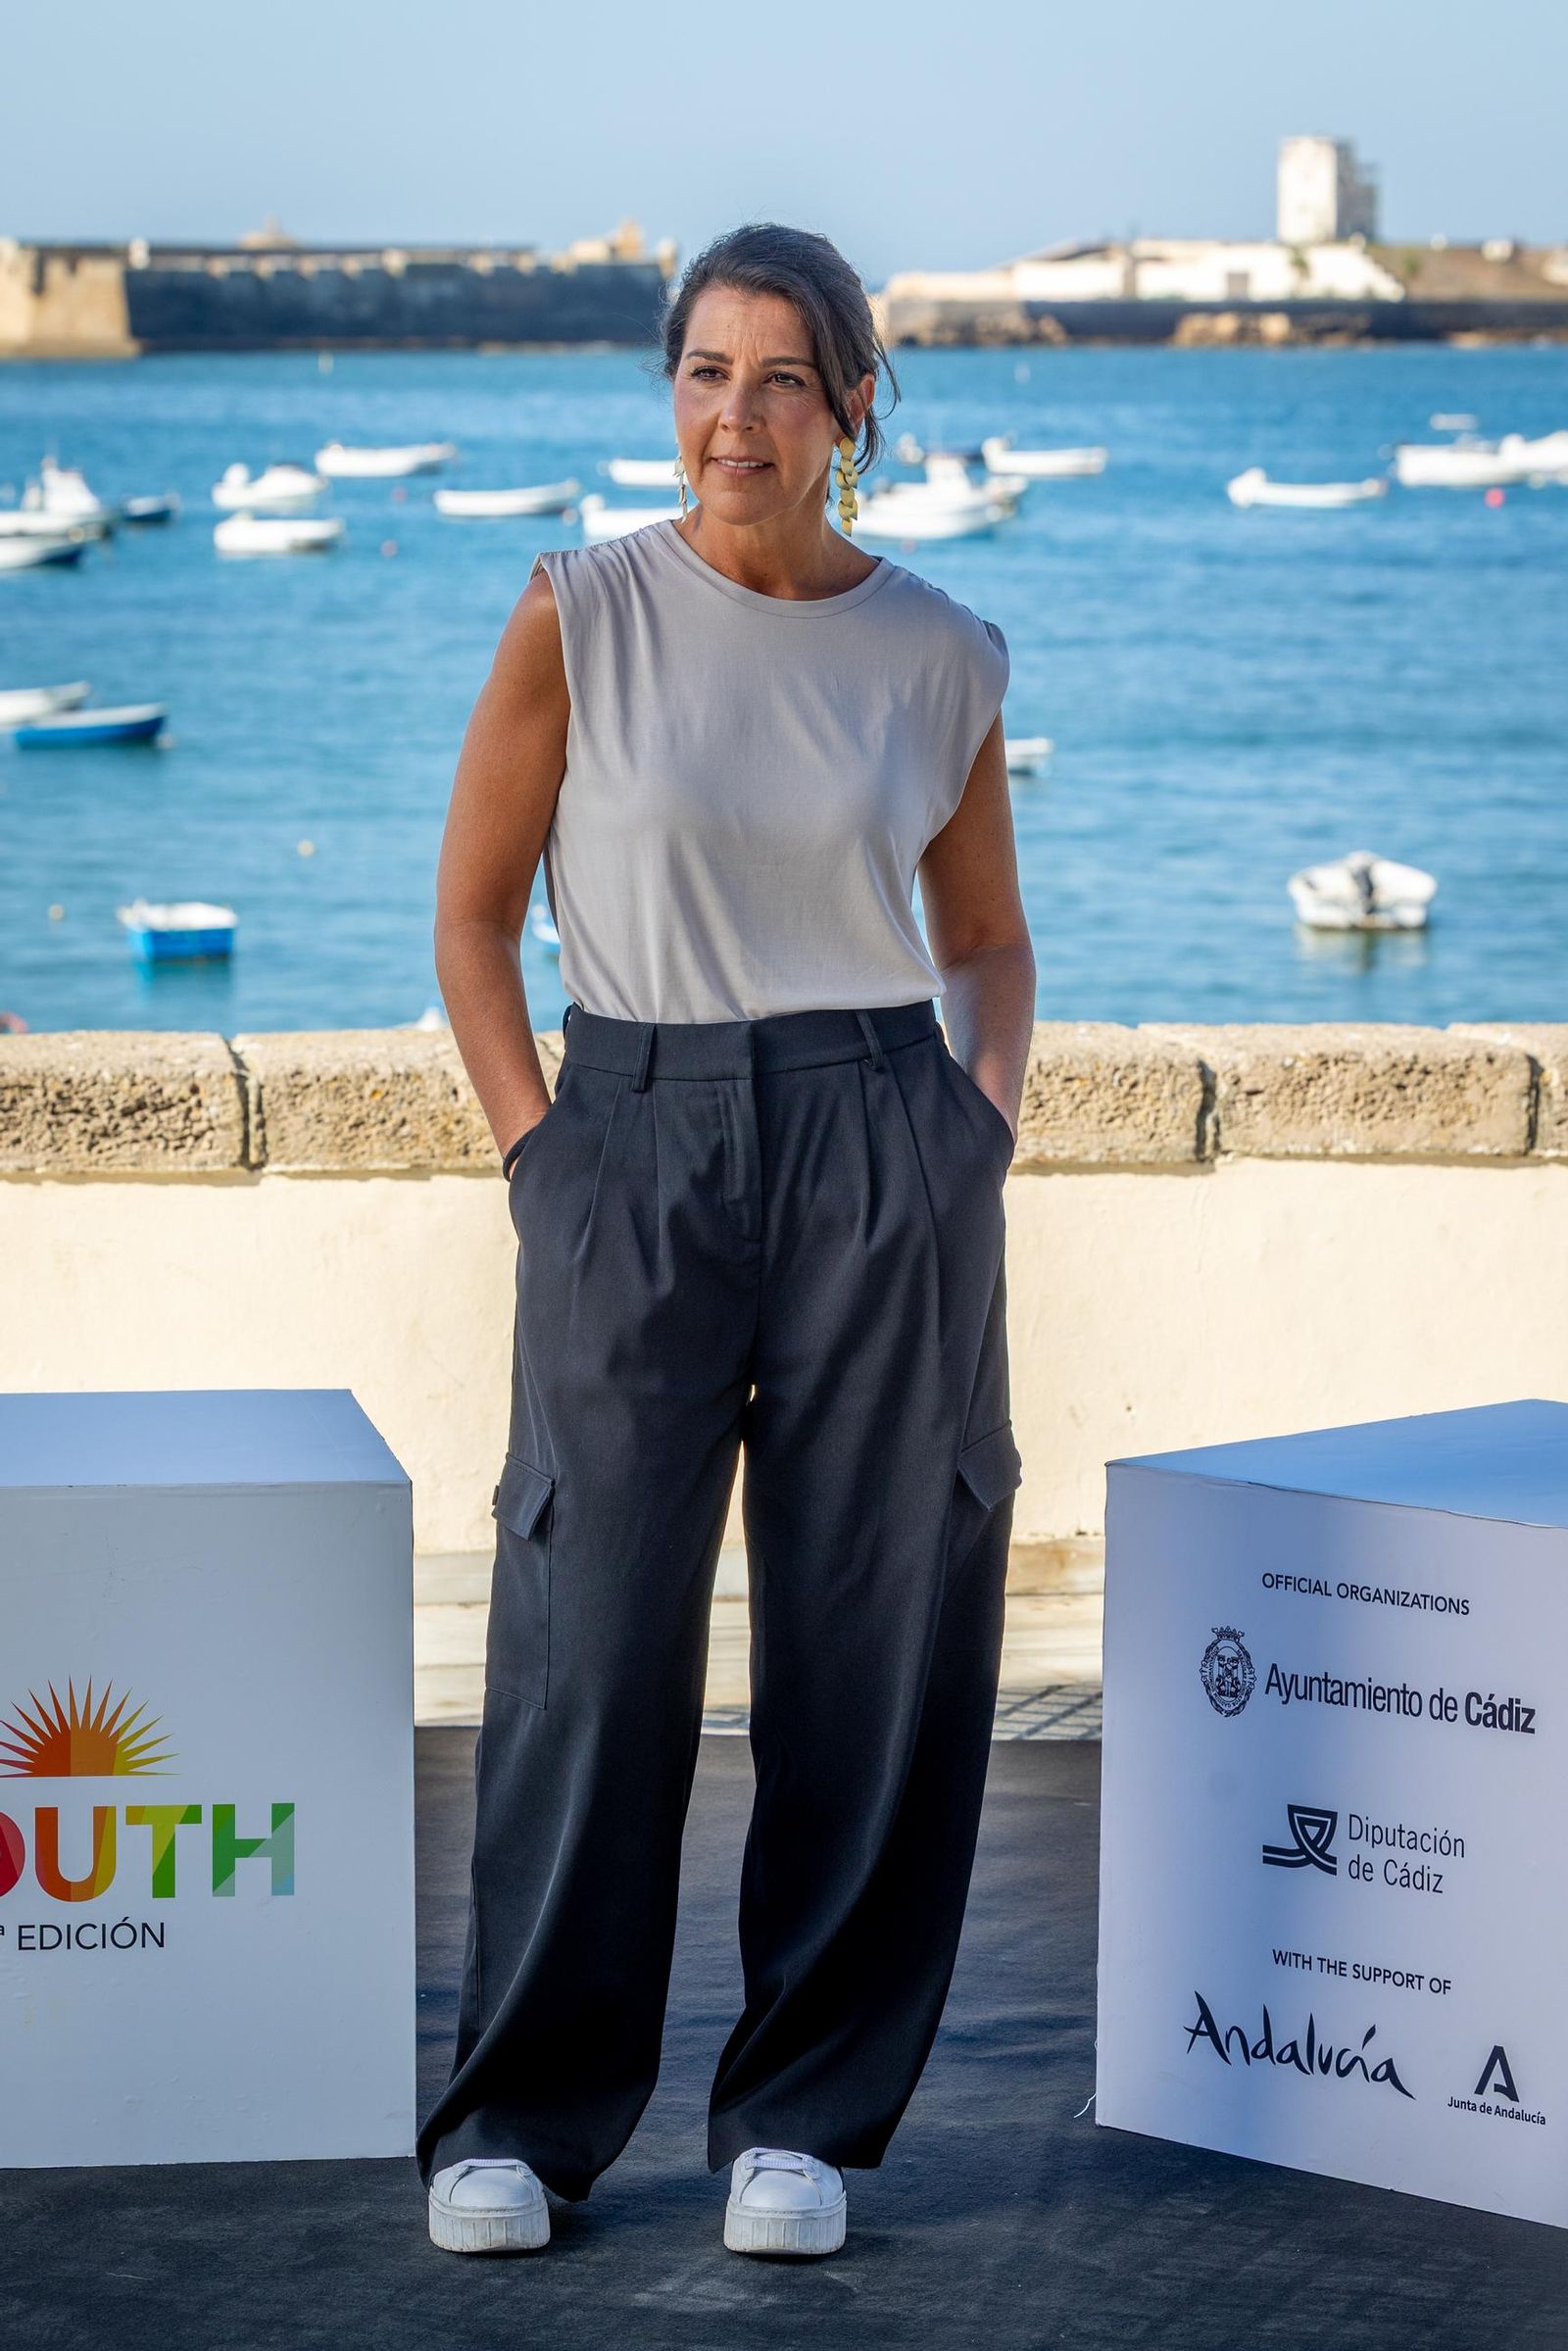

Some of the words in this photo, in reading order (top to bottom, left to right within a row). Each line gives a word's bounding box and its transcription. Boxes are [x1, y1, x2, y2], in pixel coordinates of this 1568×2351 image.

[1261, 1572, 1333, 1597] OFFICIAL
[1336, 1583, 1470, 1616] ORGANIZATIONS
[1264, 1663, 1423, 1717] Ayuntamiento
[1429, 1688, 1458, 1723] de
[1464, 1691, 1537, 1735] Cádiz
[0, 1802, 295, 1902] UTH
[1348, 1813, 1466, 1858] Diputación
[1348, 1854, 1374, 1883] de
[1383, 1858, 1444, 1894] Cádiz
[18, 1917, 165, 1951] EDICIÓN
[1272, 1948, 1312, 1972] WITH
[1317, 1957, 1348, 1978] THE
[1352, 1963, 1425, 1991] SUPPORT
[1429, 1977, 1452, 1995] OF
[1183, 1990, 1417, 2101] Andalucía
[1447, 2096, 1478, 2113] Junta
[1479, 2101, 1494, 2116] de
[1494, 2104, 1546, 2127] Andalucía
